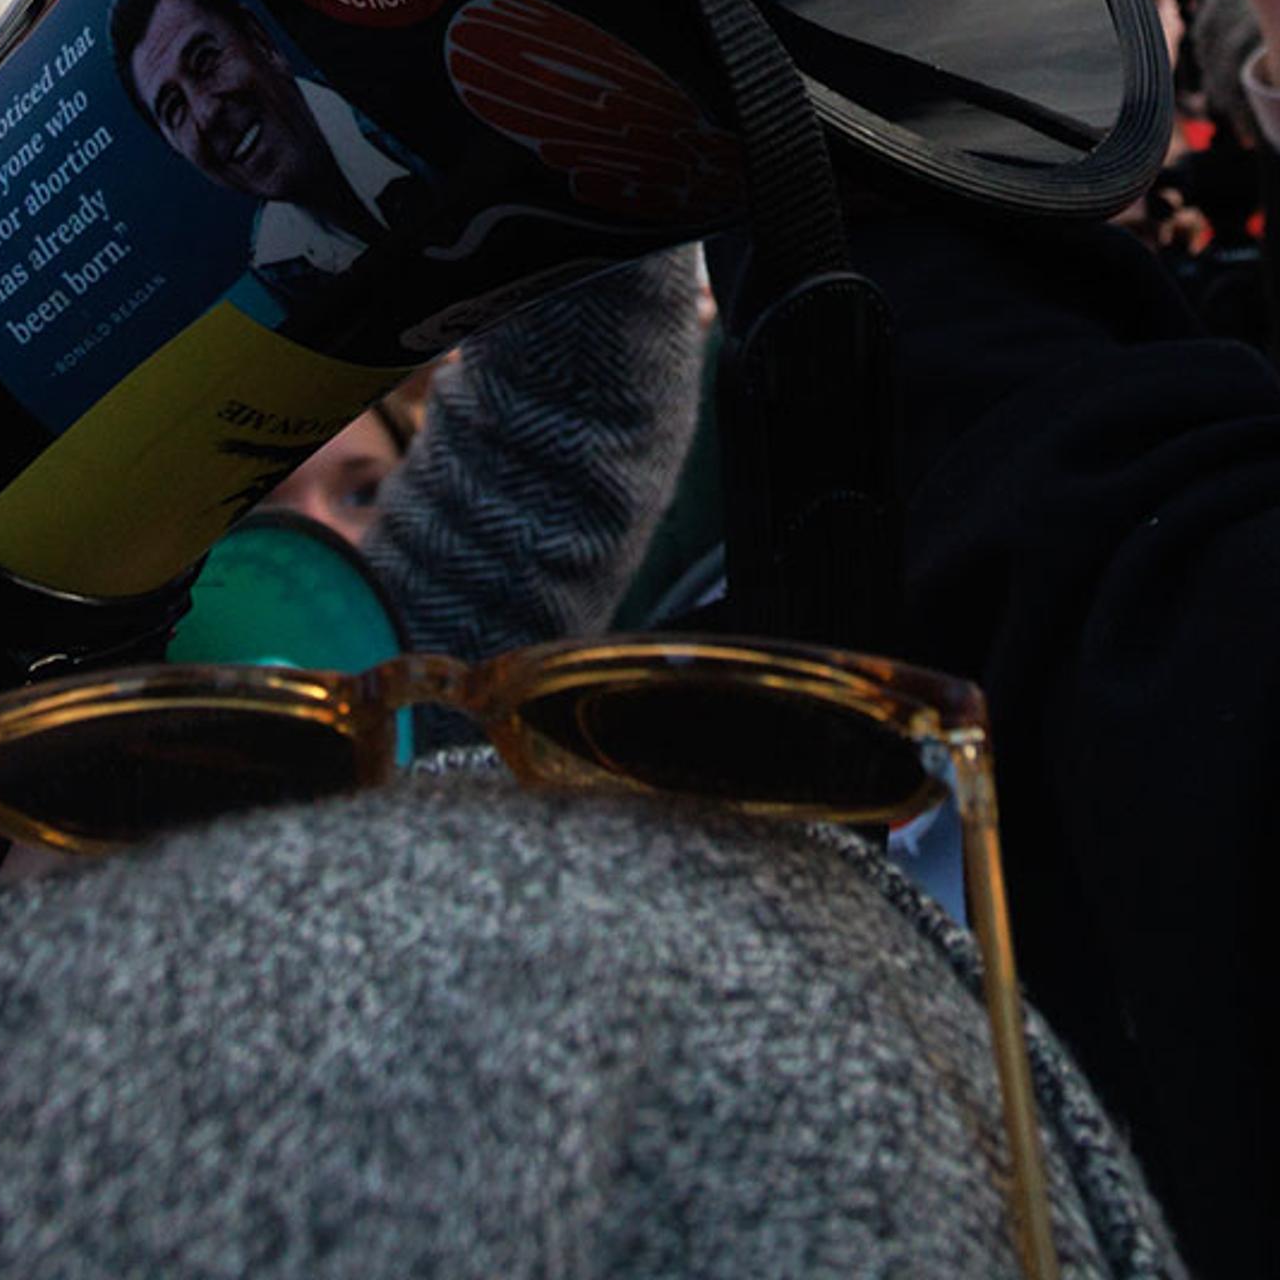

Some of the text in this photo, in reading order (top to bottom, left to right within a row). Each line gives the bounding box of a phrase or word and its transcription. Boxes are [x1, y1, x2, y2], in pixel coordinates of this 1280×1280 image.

[53, 26, 97, 78] that
[45, 88, 90, 138] who
[25, 124, 116, 218] abortion
[31, 187, 111, 274] already
[4, 289, 72, 346] been
